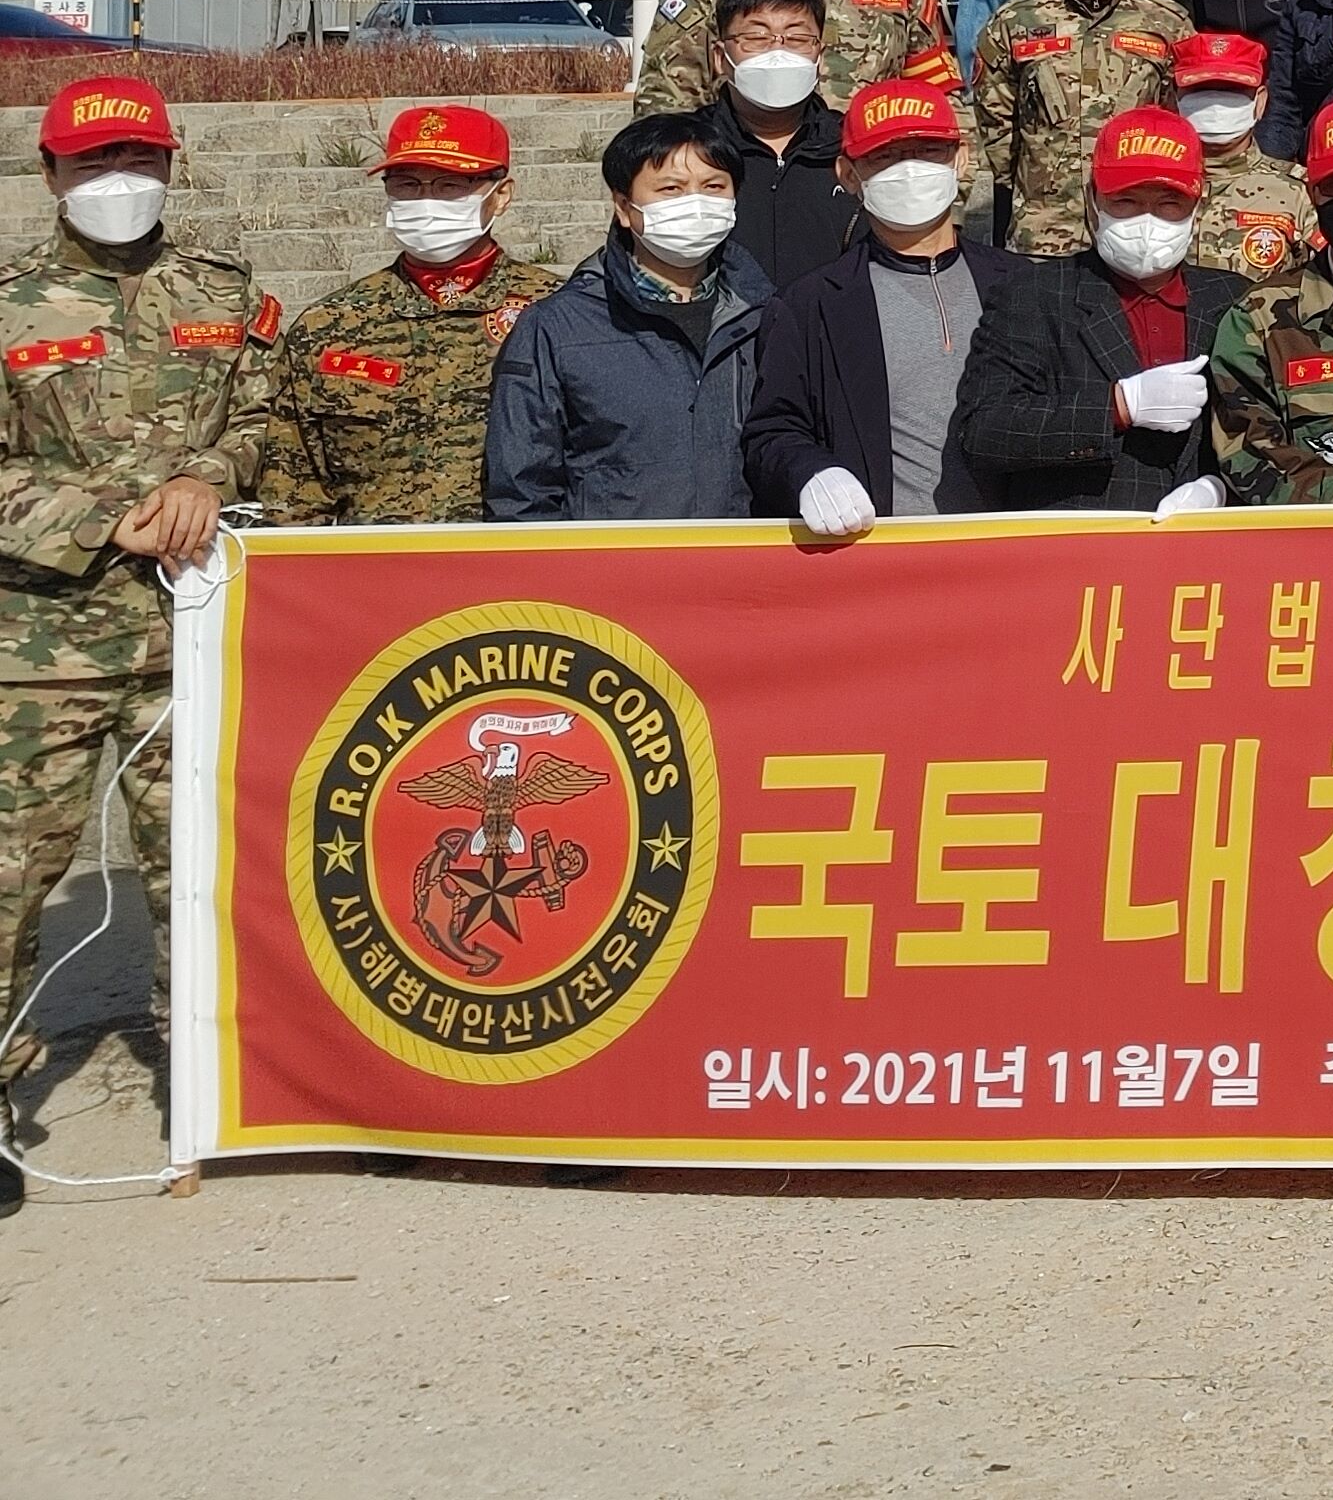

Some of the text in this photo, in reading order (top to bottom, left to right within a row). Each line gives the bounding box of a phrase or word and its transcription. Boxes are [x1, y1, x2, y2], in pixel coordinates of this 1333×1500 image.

[73, 98, 152, 127] ROKMC
[864, 97, 935, 131] ROKMC
[1117, 135, 1187, 162] ROKMC
[412, 644, 575, 711] MARINE
[588, 669, 679, 796] CORPS
[331, 892, 669, 1045] 사)해병대안산시전우회
[703, 1047, 828, 1110] 일시:
[841, 1045, 1026, 1109] 2021년
[1047, 1042, 1261, 1108] 11월7일
